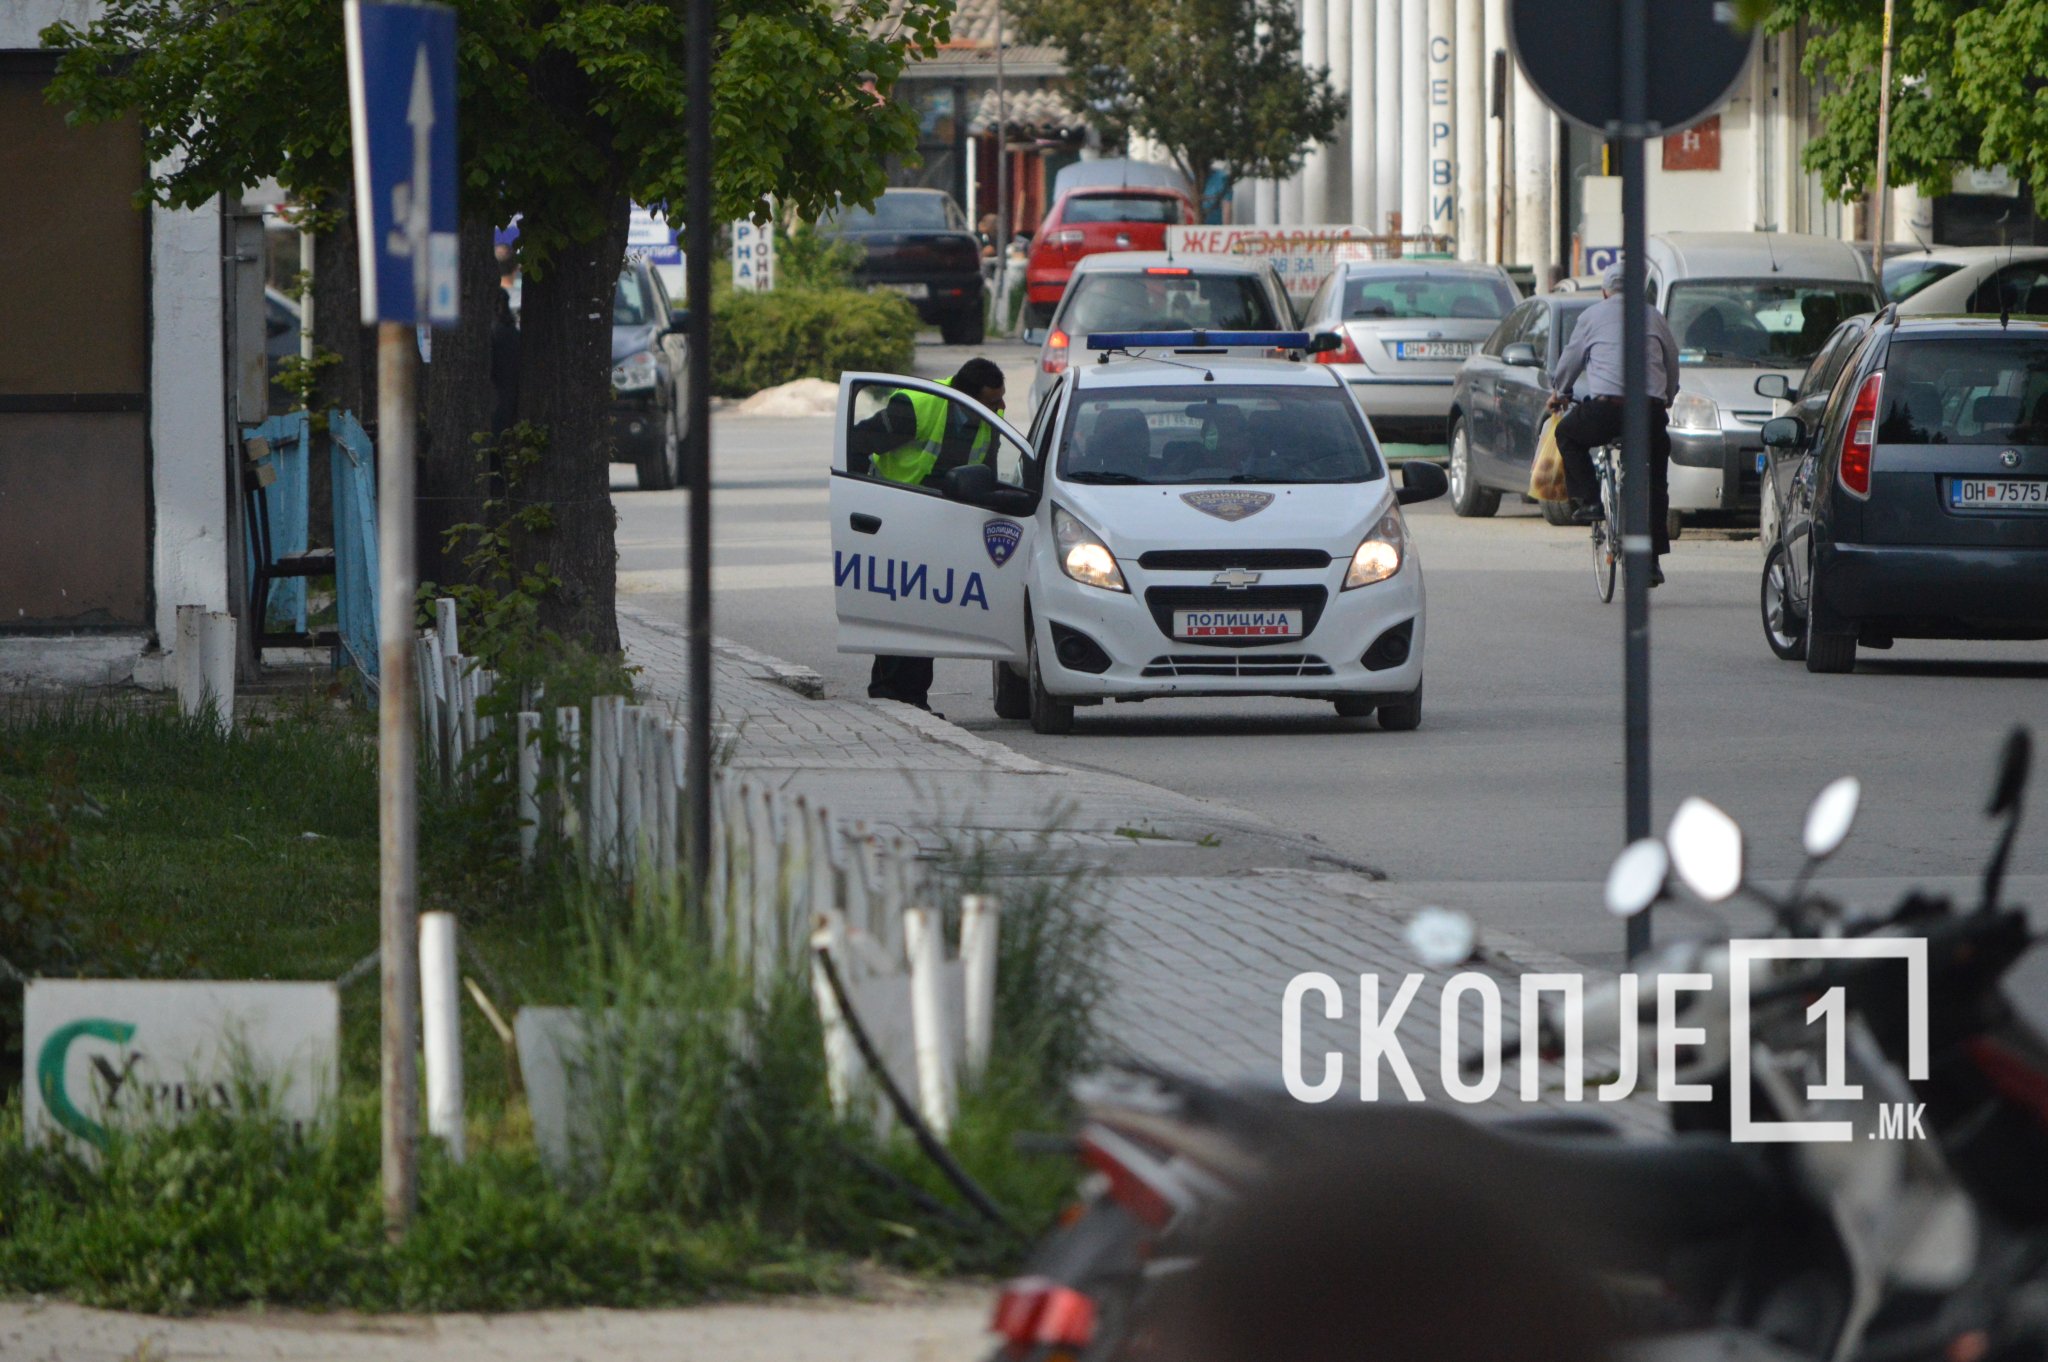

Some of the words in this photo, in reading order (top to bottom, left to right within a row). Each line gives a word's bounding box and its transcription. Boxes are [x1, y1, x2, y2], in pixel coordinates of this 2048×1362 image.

[1964, 483, 1985, 500] OH
[1998, 483, 2040, 501] 7575
[834, 550, 989, 611] ИЦИЈА
[1187, 613, 1288, 626] ПОЛИЦИЈА
